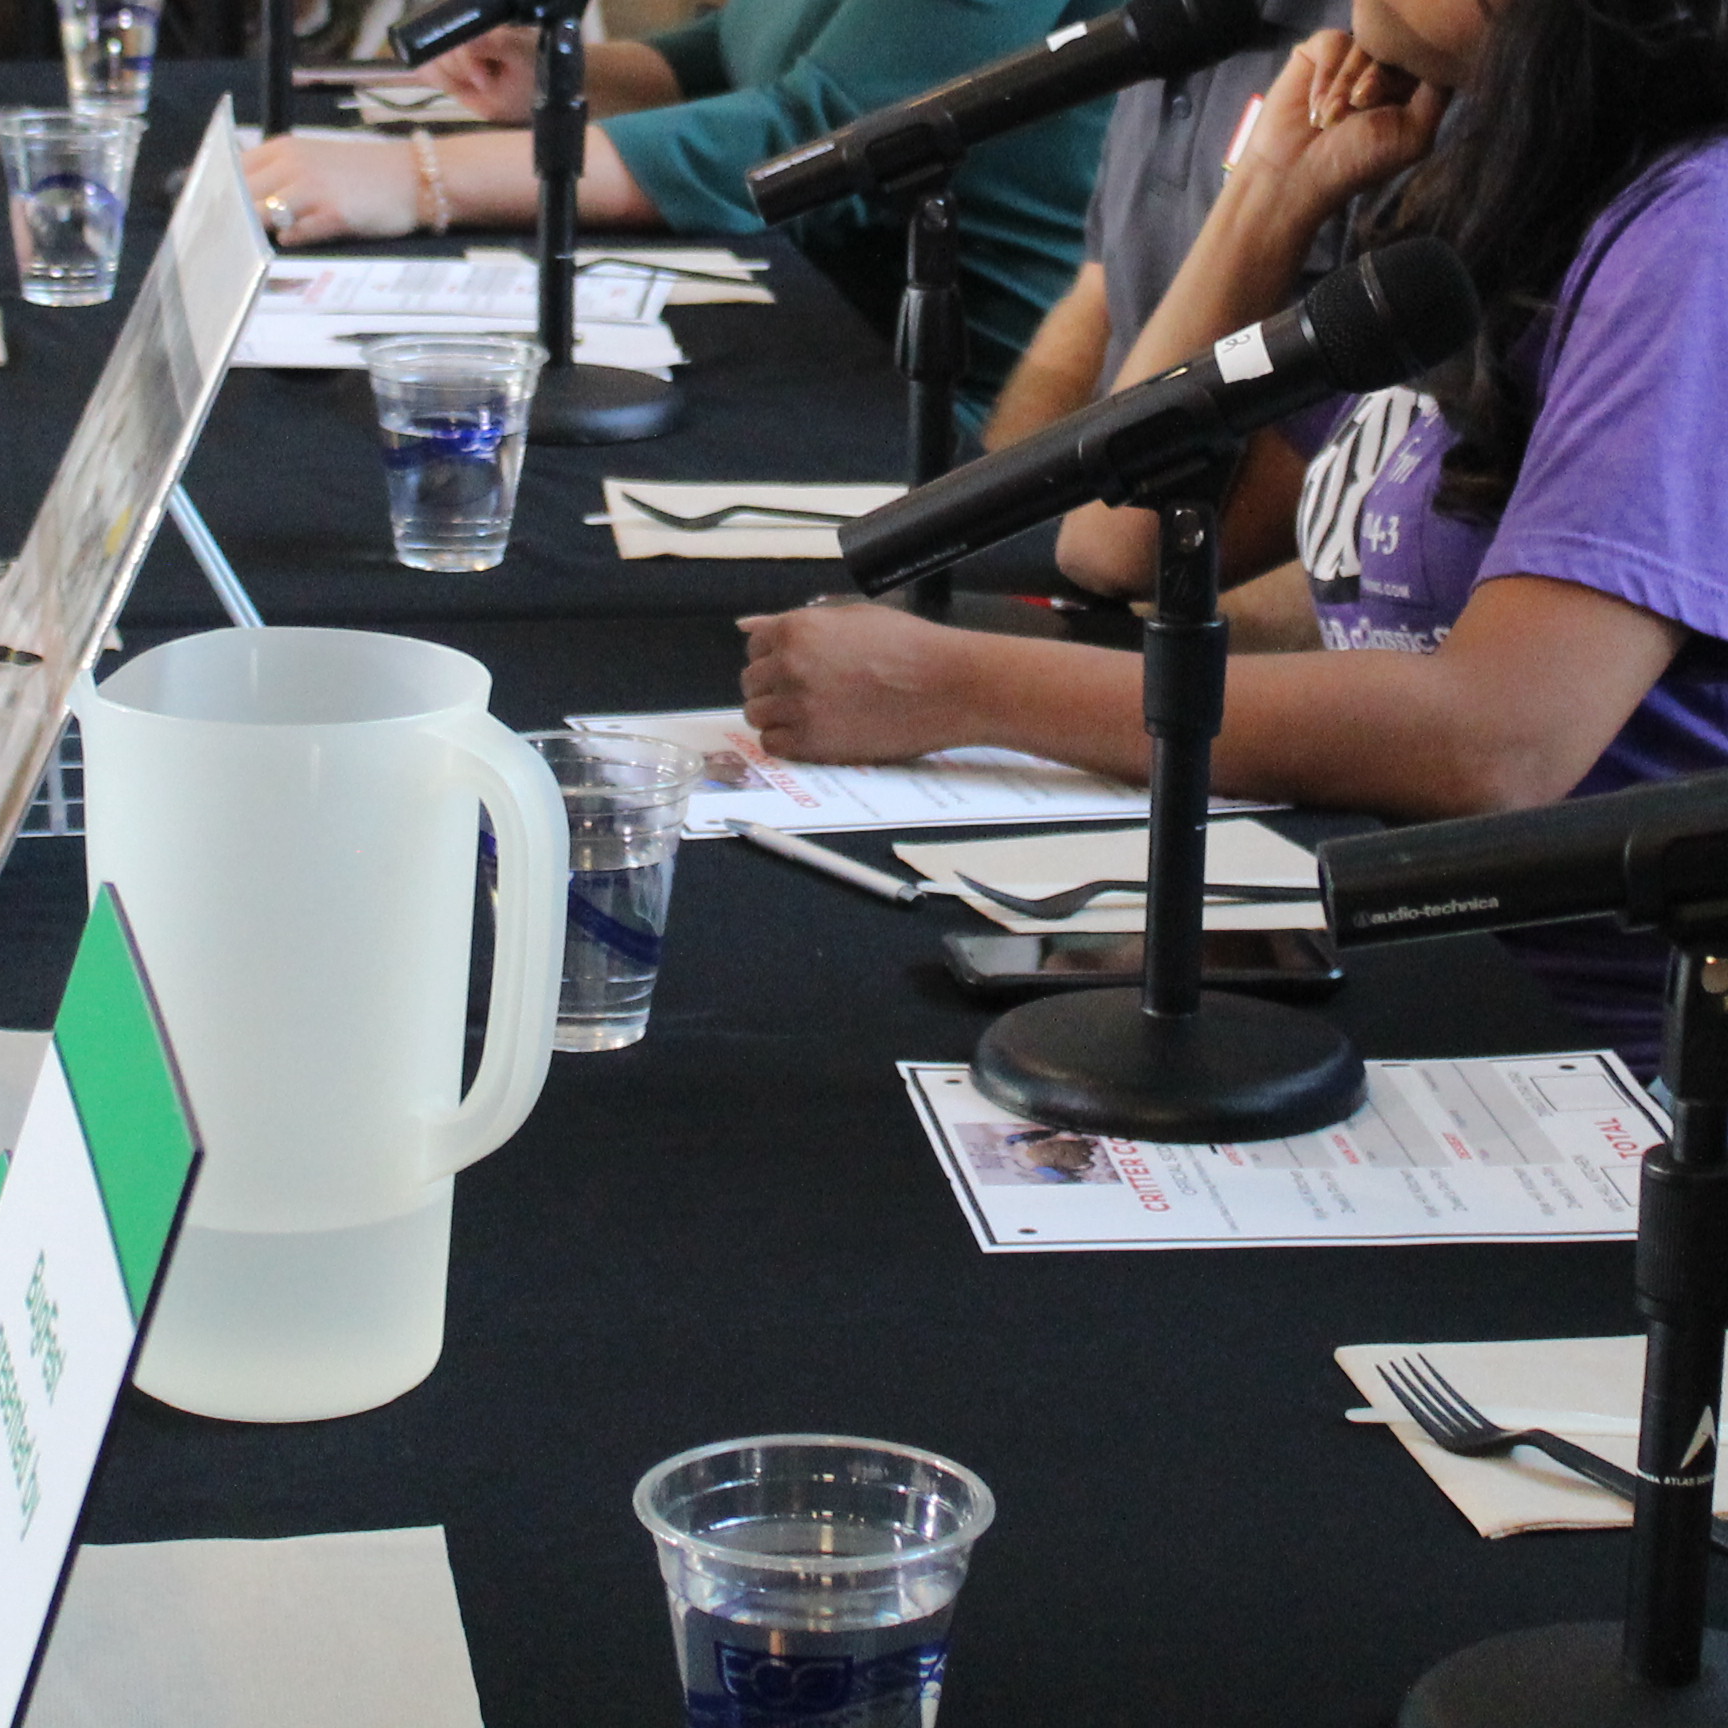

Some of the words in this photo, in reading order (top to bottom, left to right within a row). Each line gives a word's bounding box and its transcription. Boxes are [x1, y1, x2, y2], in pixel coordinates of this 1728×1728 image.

[1372, 895, 1500, 925] audio-technica
[1590, 1117, 1647, 1159] TOTAL
[1117, 1157, 1174, 1212] CRITTER
[26, 1249, 67, 1406] BugFest
